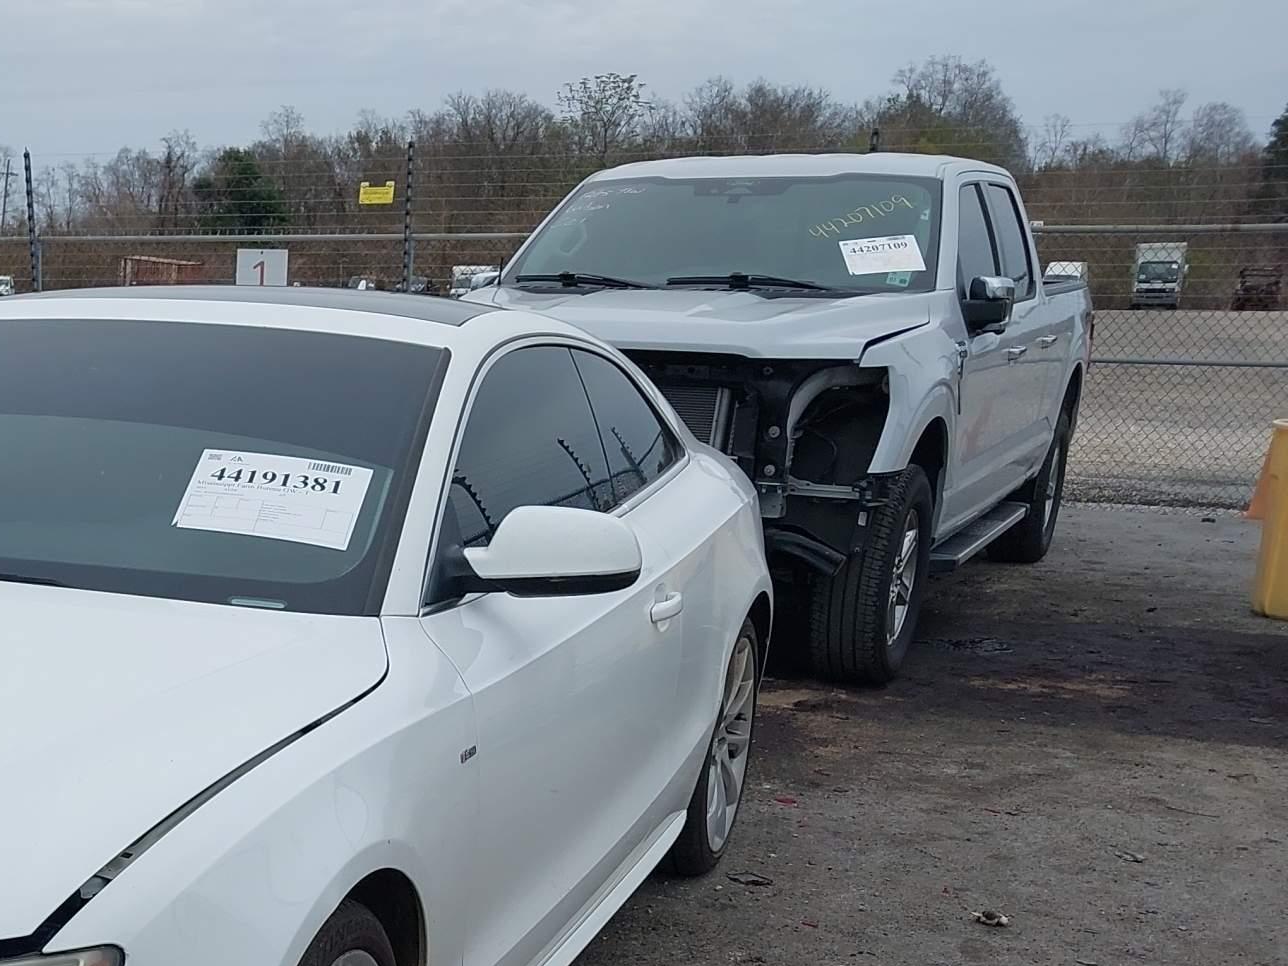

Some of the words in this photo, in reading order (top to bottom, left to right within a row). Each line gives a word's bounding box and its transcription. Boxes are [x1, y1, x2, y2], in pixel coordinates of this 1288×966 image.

[808, 195, 913, 238] 44207109
[849, 242, 908, 254] 44207109
[253, 261, 265, 284] 1
[210, 466, 342, 495] 44191381
